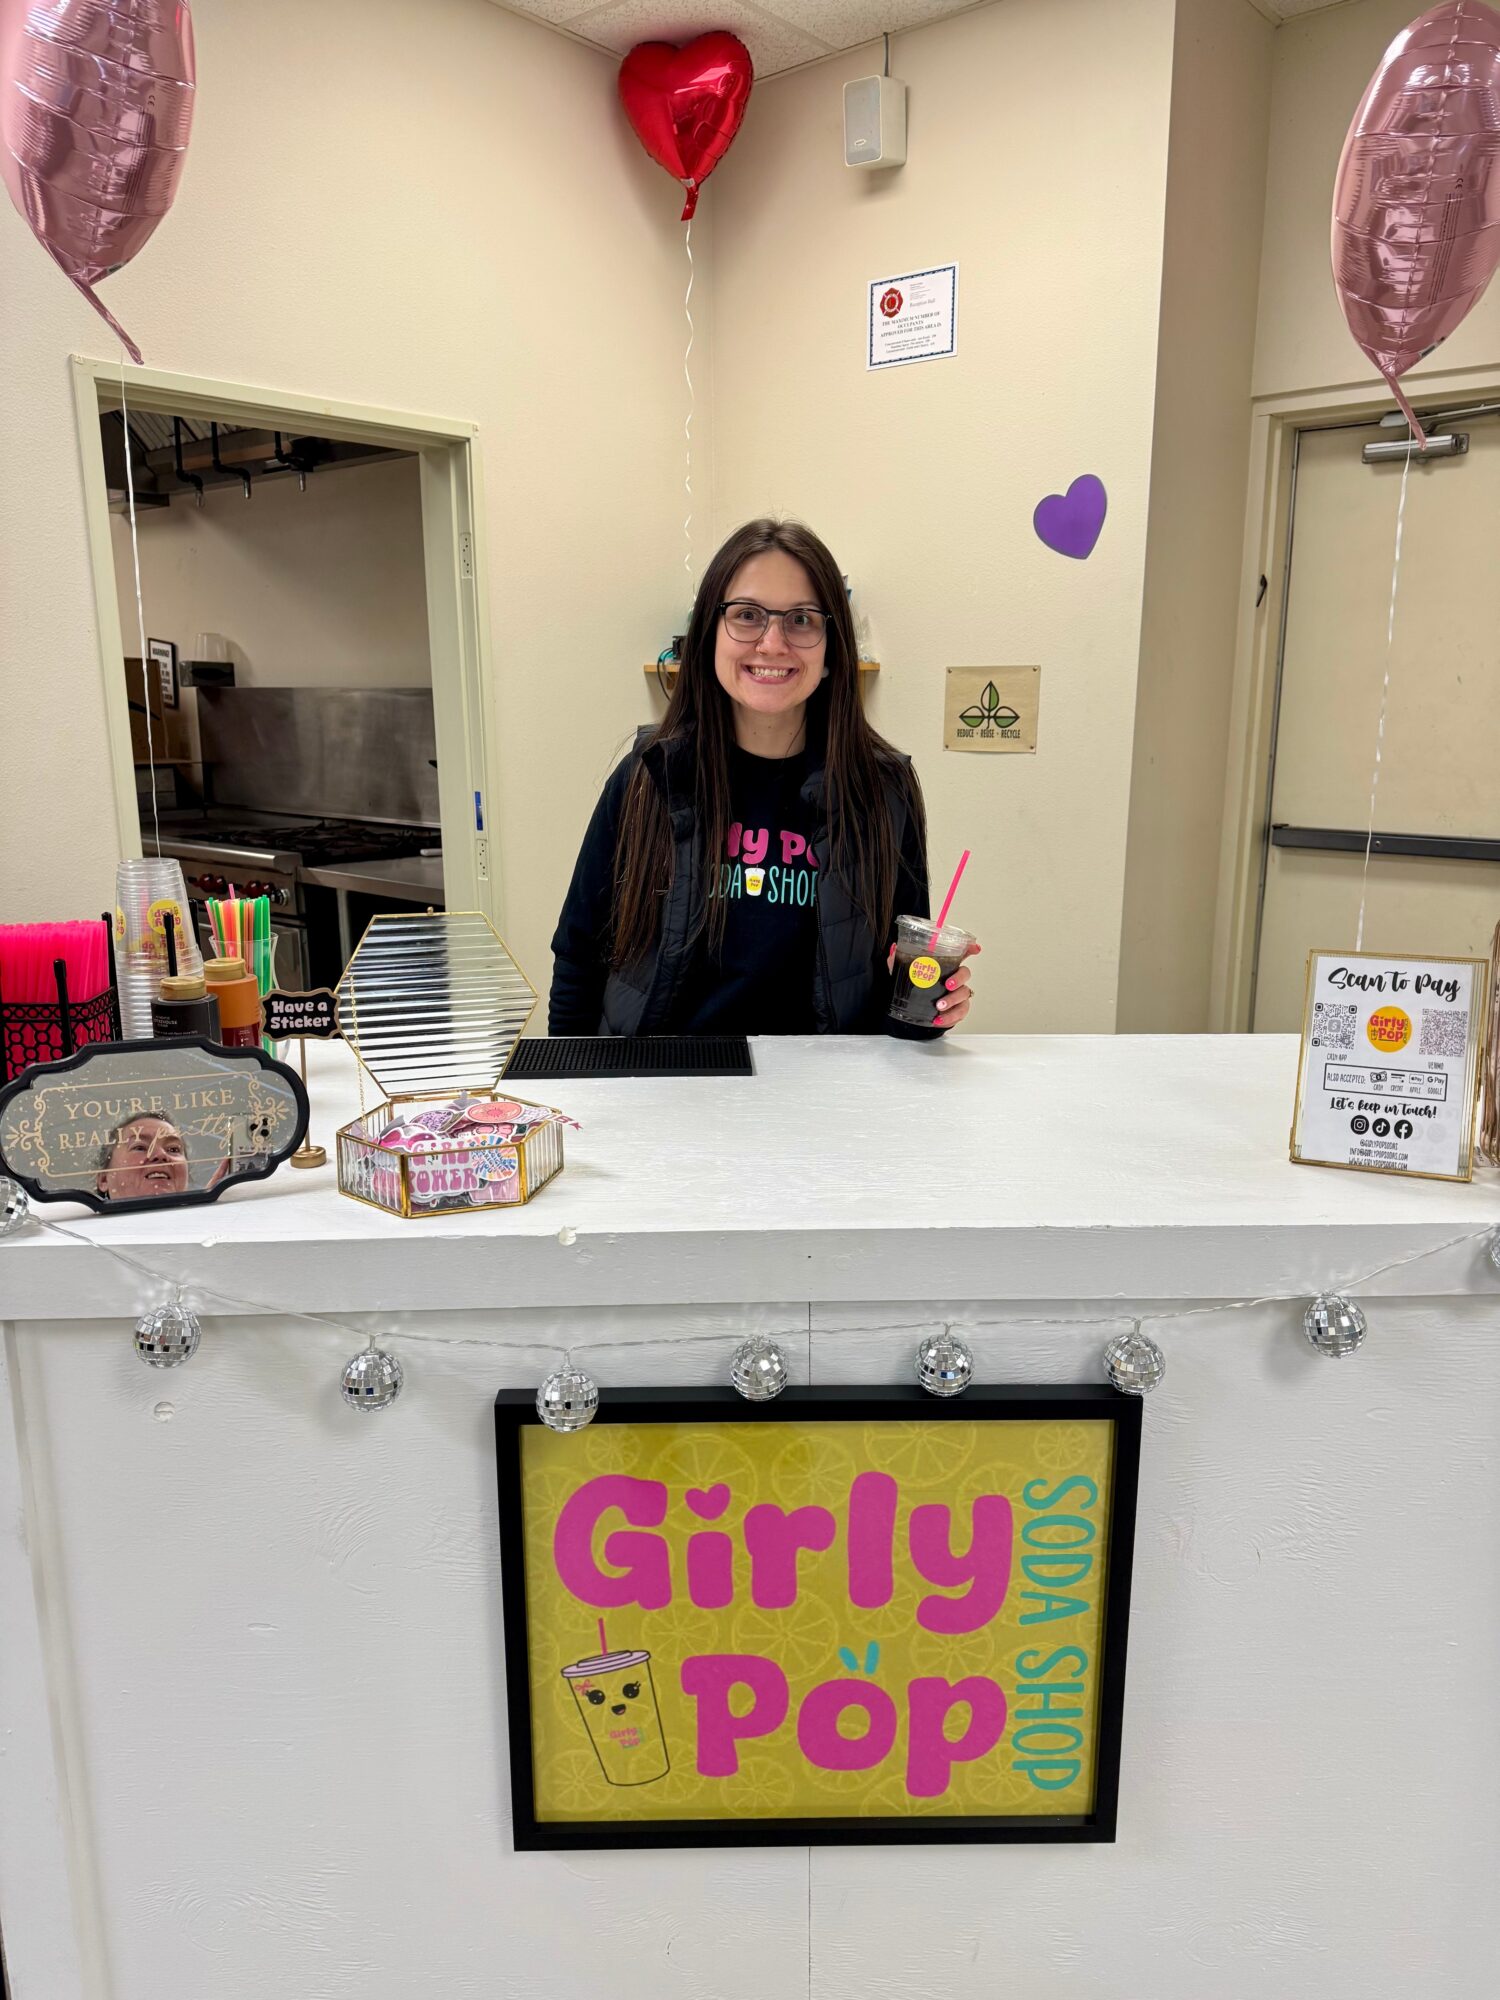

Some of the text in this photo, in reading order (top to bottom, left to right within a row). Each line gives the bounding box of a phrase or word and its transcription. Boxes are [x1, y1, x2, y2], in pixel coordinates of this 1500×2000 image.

[956, 728, 1021, 739] REDUCE REUSE RECYCLE
[912, 961, 936, 973] Girly
[917, 970, 934, 981] Pop
[1327, 967, 1461, 1003] Scan to Pay
[271, 1000, 328, 1014] Have a
[270, 1016, 331, 1030] Sticker
[1370, 1014, 1404, 1031] Girly
[1378, 1027, 1404, 1042] Pop
[1327, 1072, 1366, 1085] ALSO ACCEPTED:
[172, 1088, 235, 1110] LIKE
[1330, 1097, 1437, 1119] Let's keep in touch!
[58, 1125, 145, 1151] REALLY
[408, 1167, 478, 1194] POWER
[553, 1471, 1013, 1635] Girly
[1011, 1475, 1099, 1791] SODA SHOP
[680, 1653, 1008, 1797] Pop
